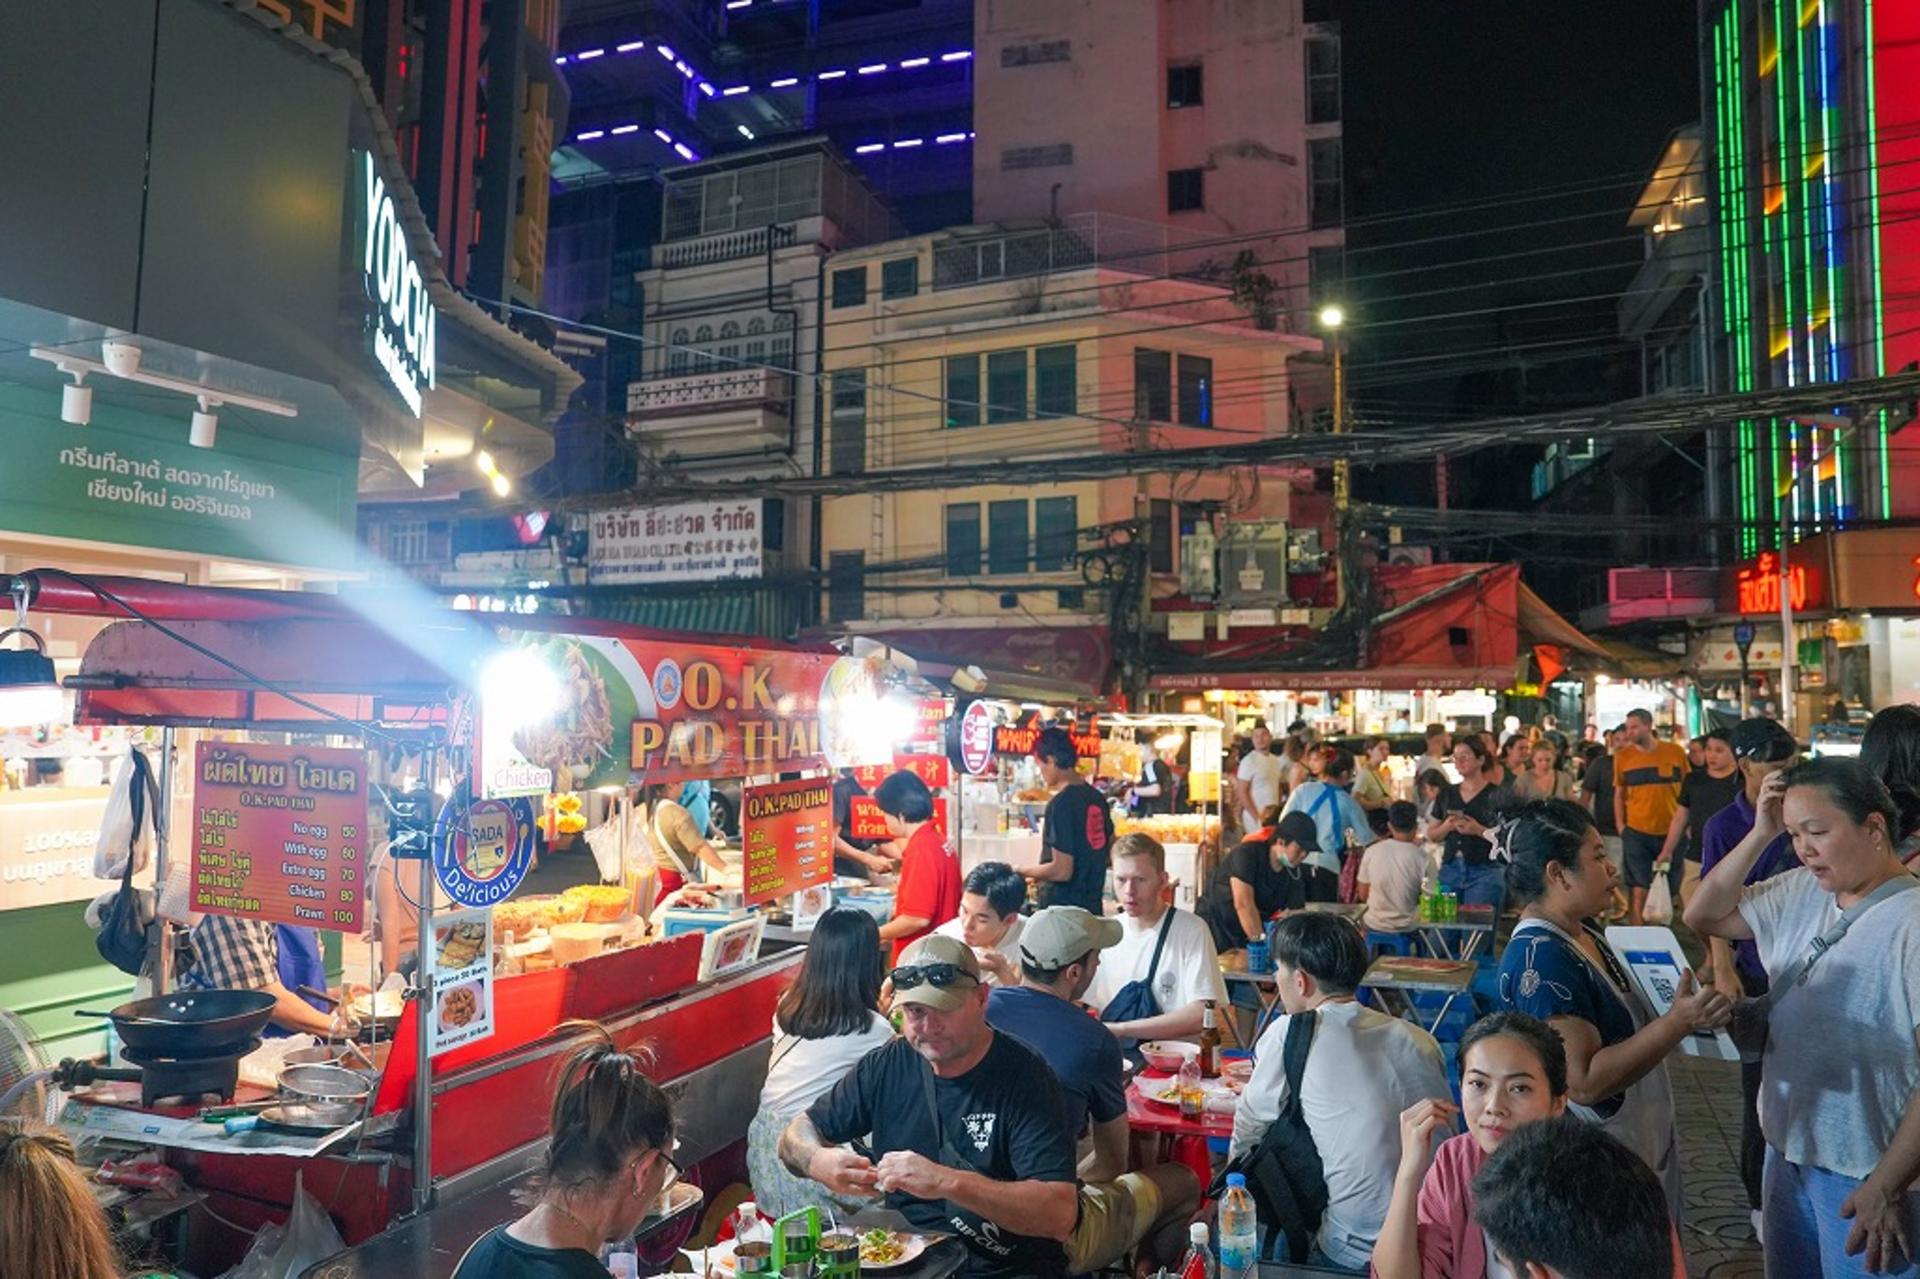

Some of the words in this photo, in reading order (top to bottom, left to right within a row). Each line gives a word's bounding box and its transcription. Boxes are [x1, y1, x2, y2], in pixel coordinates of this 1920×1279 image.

[365, 150, 436, 391] YODCHA
[59, 446, 161, 480] กรีนทีลาเต้
[87, 478, 167, 508] เชียงใหม่
[595, 512, 640, 539] บริษัท
[711, 505, 756, 532] จำกัด
[631, 720, 725, 769] PAD
[738, 719, 820, 761] THAI
[203, 751, 286, 787] ผัดไทย
[495, 768, 551, 788] Chicken
[290, 796, 315, 811] THAI
[804, 788, 829, 808] THAI
[293, 823, 309, 835] No
[309, 826, 328, 839] egg
[472, 824, 504, 841] SADA
[283, 841, 307, 855] With
[308, 847, 328, 860] egg
[341, 847, 356, 860] 60
[282, 861, 306, 875] Extra
[308, 867, 326, 881] egg
[341, 868, 356, 881] 70
[289, 884, 326, 900] Chicken
[444, 868, 518, 903] Delicious
[294, 905, 326, 921] Prawn
[334, 910, 354, 923] 100
[950, 1216, 977, 1238] RIP
